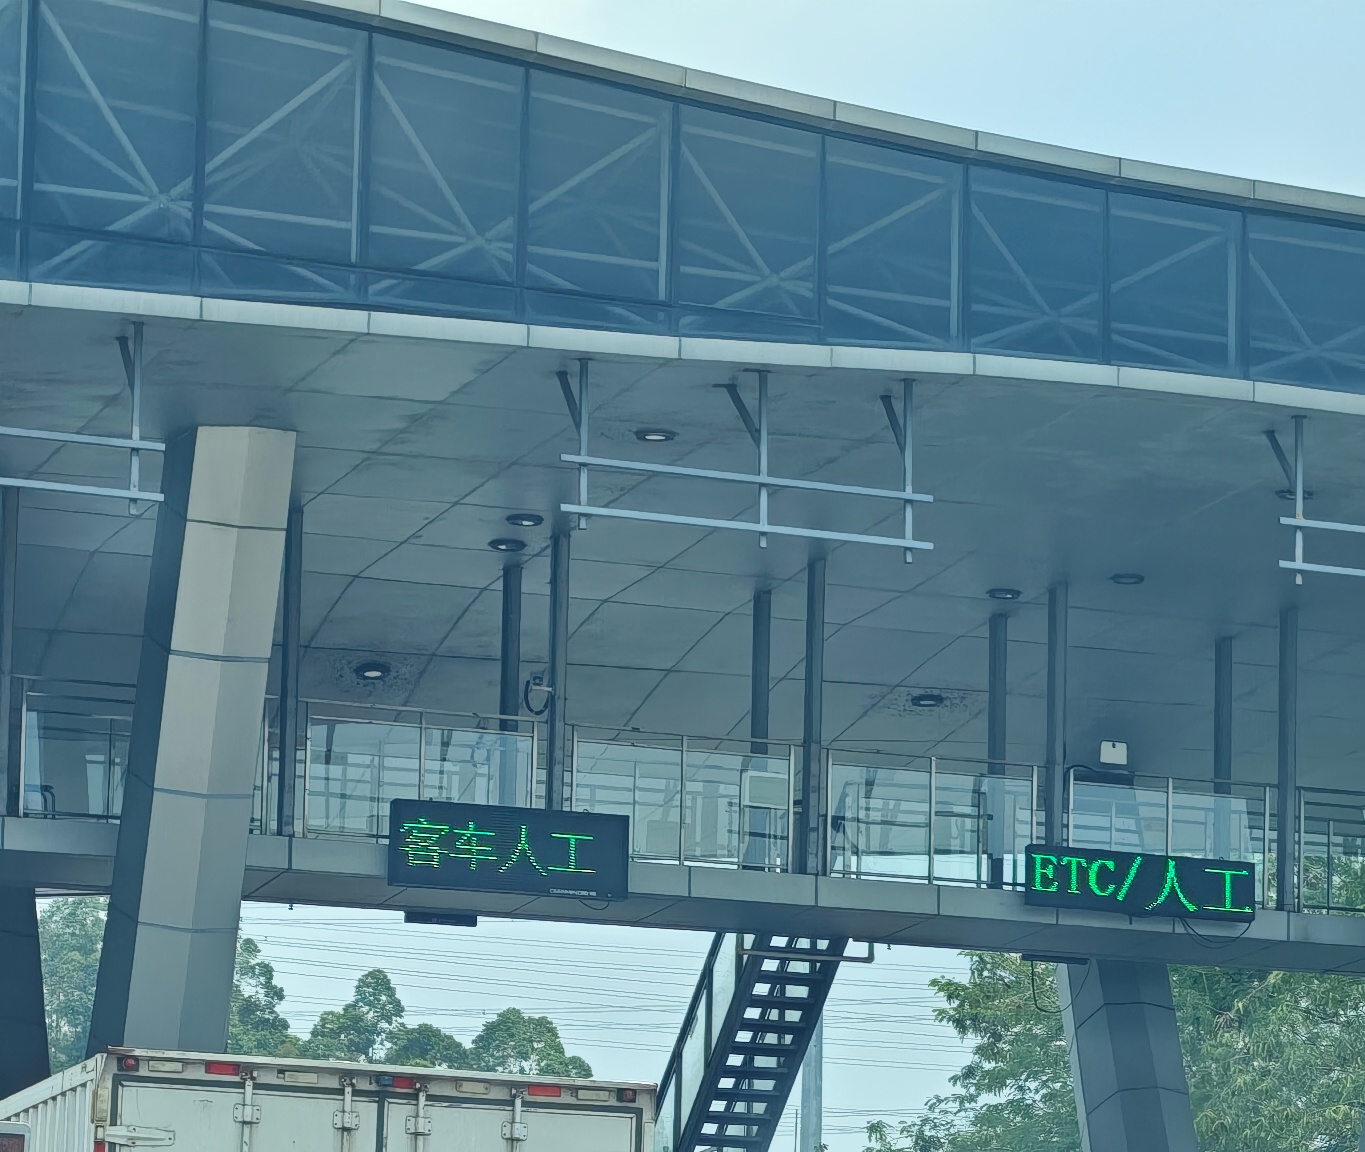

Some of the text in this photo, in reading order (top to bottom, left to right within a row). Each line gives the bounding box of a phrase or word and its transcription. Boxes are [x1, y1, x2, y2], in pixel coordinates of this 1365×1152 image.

[399, 817, 596, 876] 客车人工
[1031, 854, 1253, 912] ETC/人工
